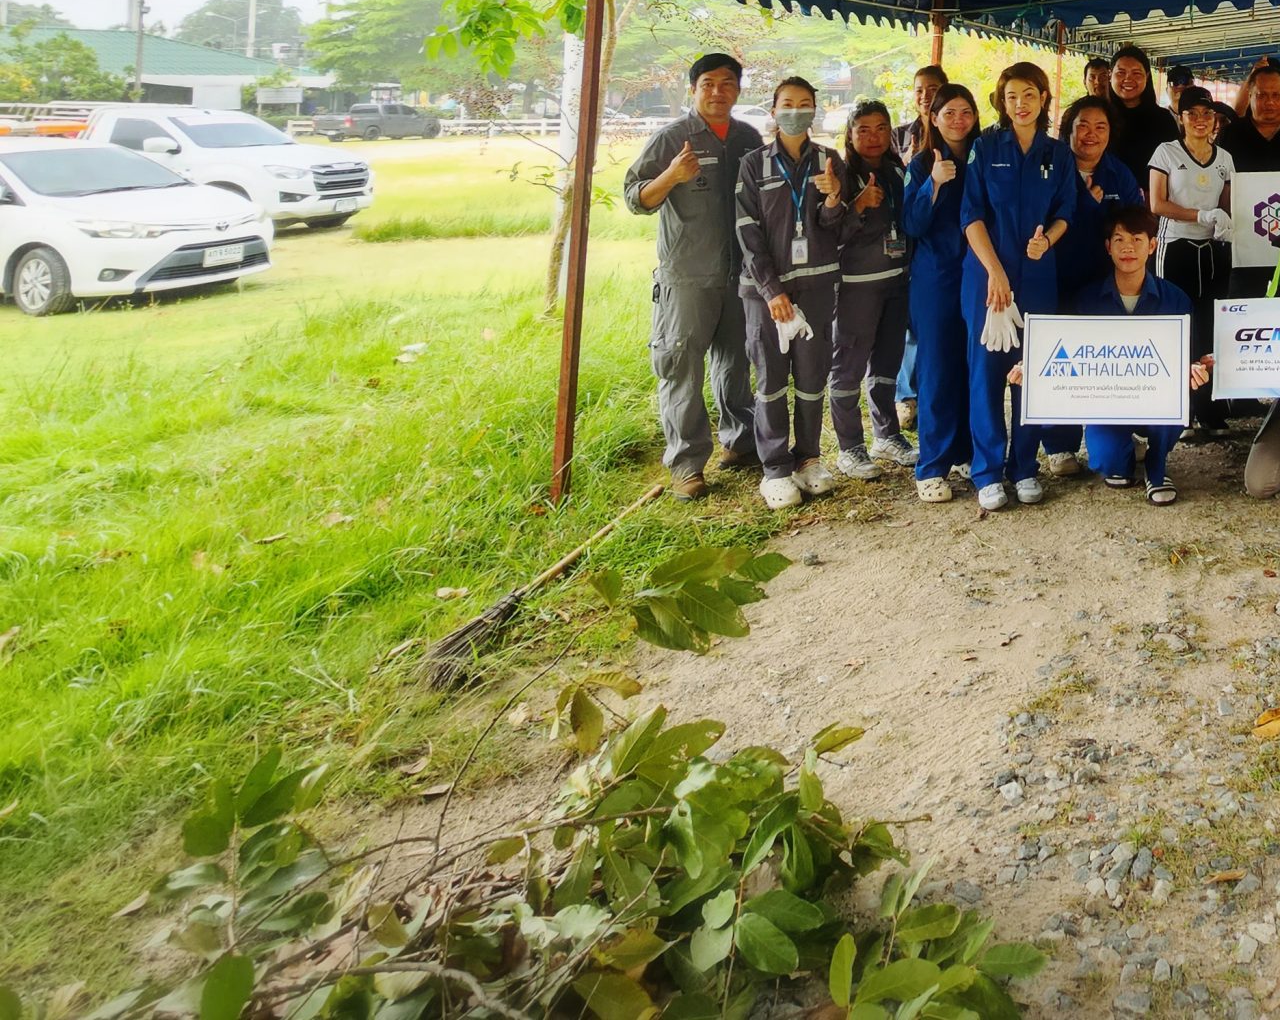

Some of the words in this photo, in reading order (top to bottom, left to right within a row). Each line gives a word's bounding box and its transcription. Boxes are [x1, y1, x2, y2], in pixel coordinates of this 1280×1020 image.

[1229, 304, 1248, 313] GC
[1072, 345, 1154, 359] ARAKAWA
[1078, 362, 1159, 377] THAILAND
